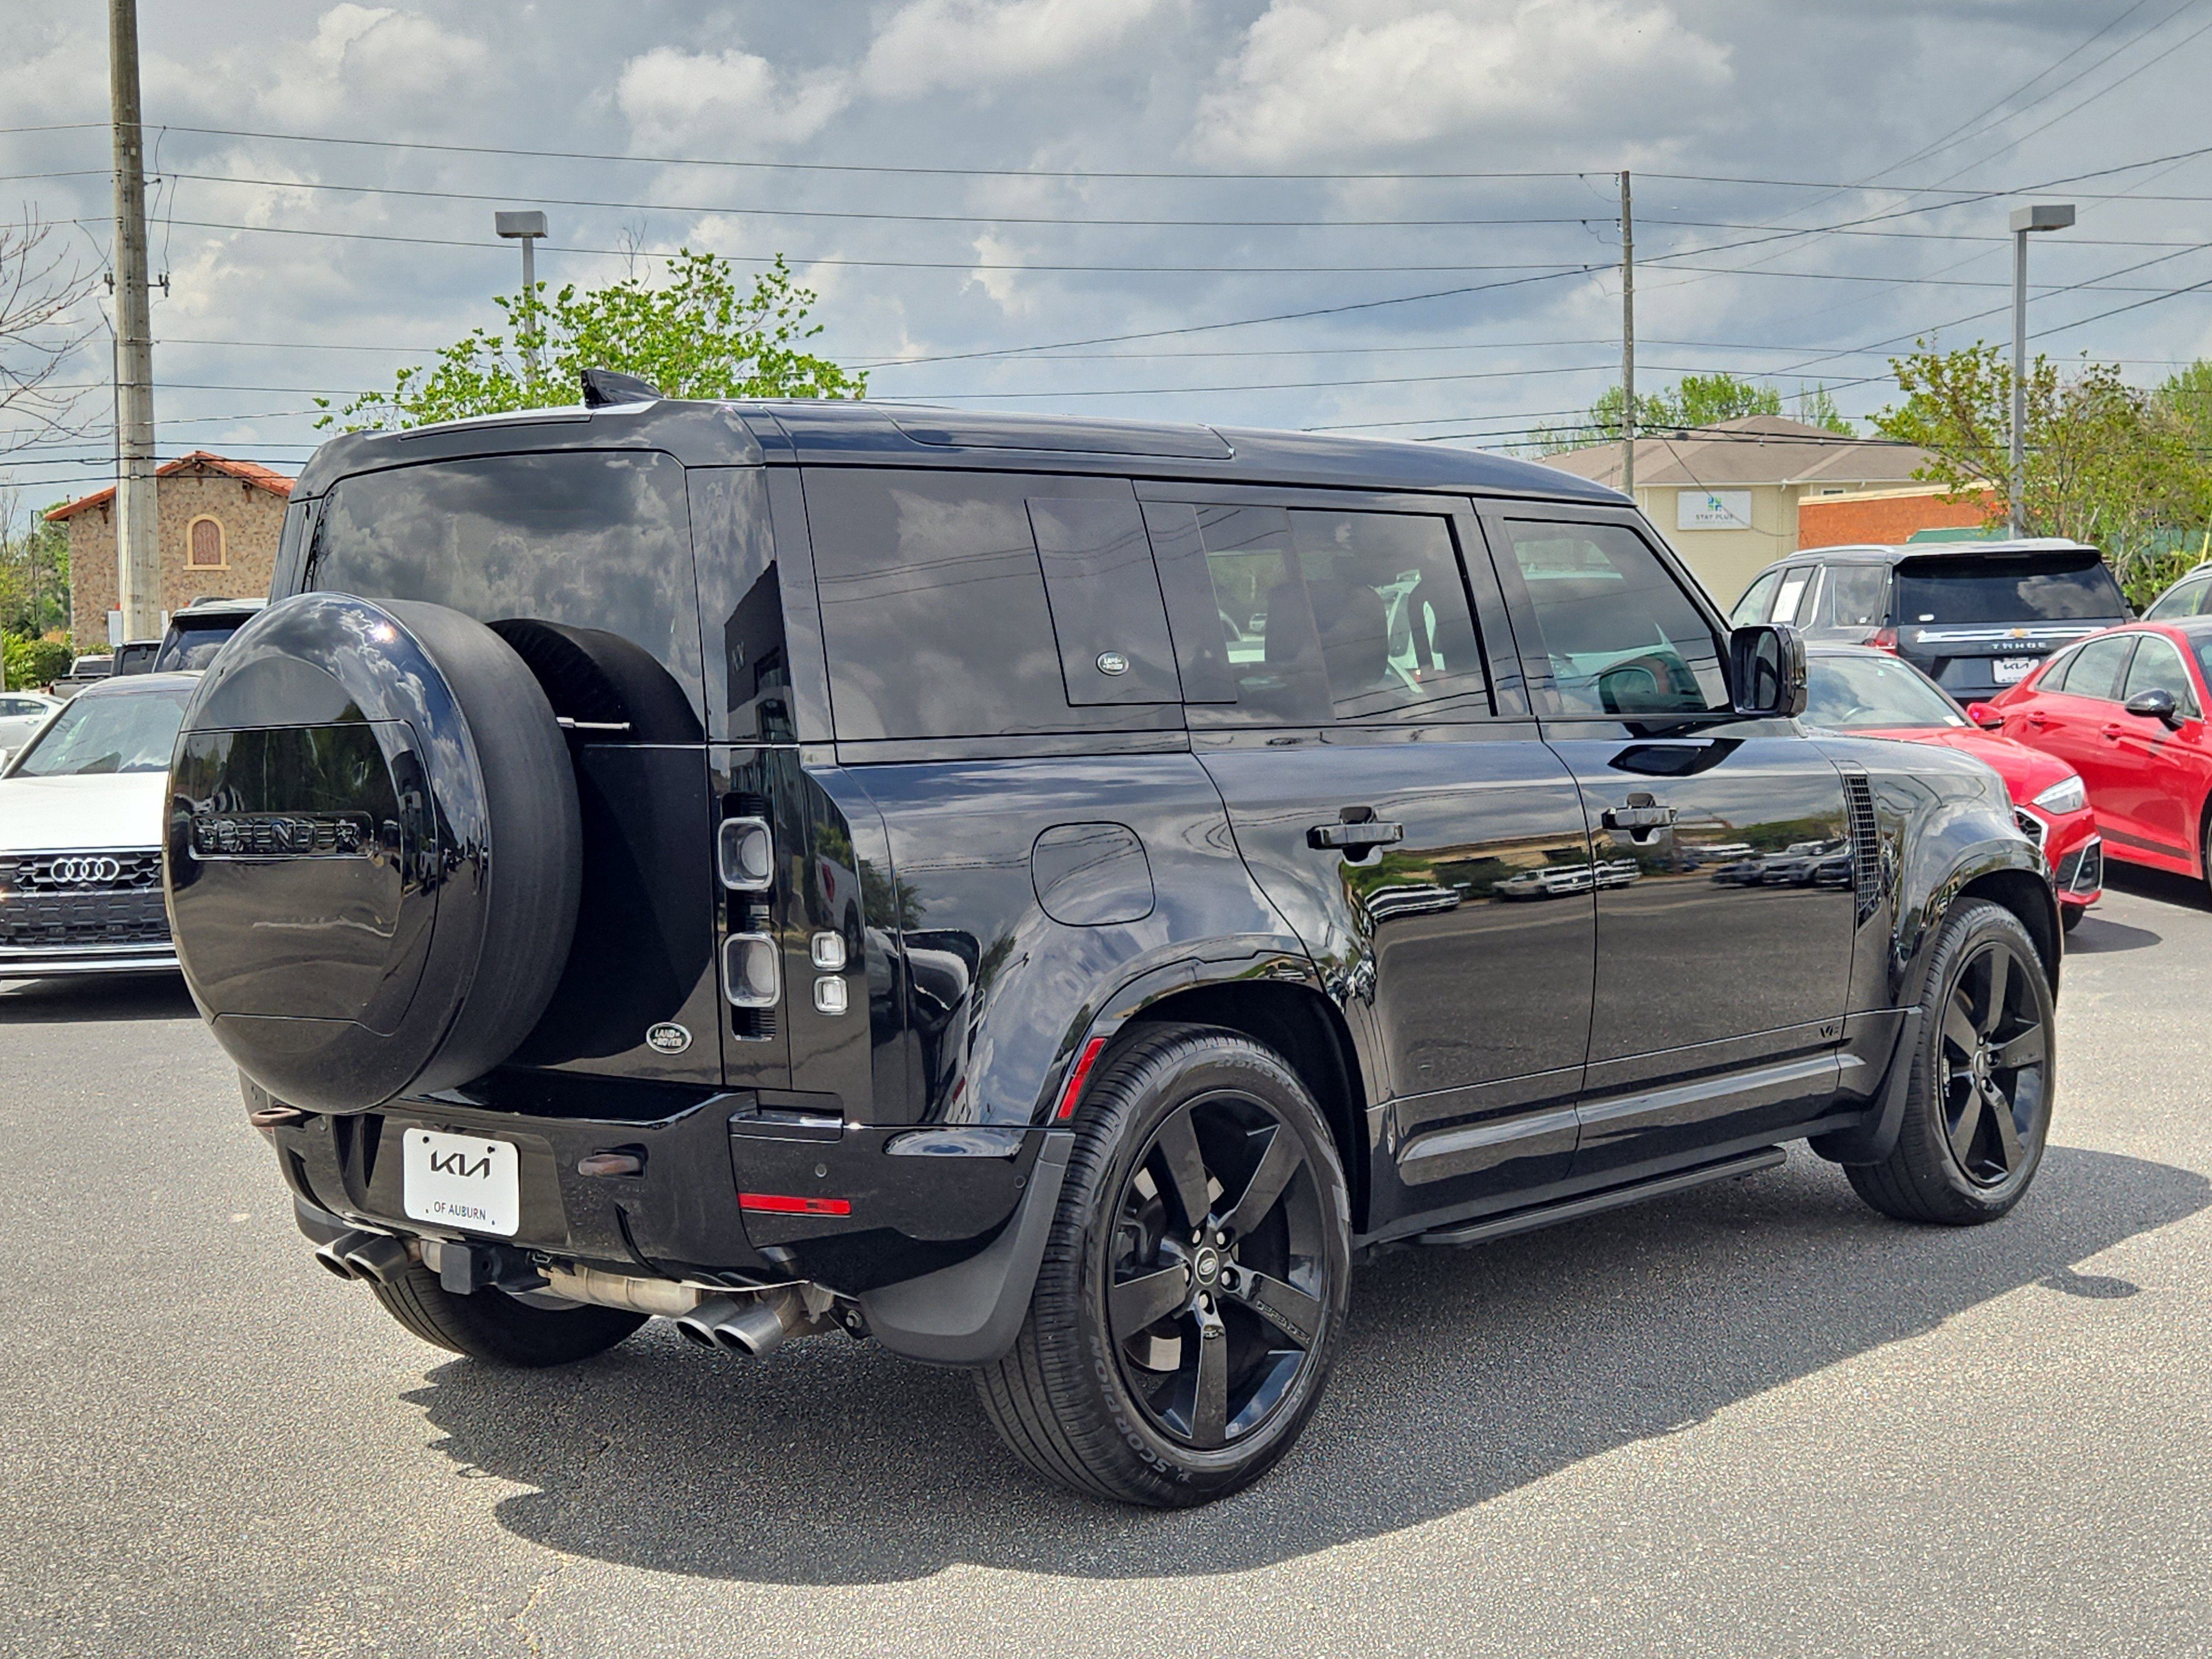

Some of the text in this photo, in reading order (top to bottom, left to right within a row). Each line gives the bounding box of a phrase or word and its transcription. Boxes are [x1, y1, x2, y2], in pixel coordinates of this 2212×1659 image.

[196, 817, 362, 853] DEFENDER
[655, 1029, 676, 1037] LAND
[430, 1149, 491, 1180] KIA
[434, 1201, 486, 1221] OF AUBURN
[1089, 1335, 1172, 1474] SCORPION
